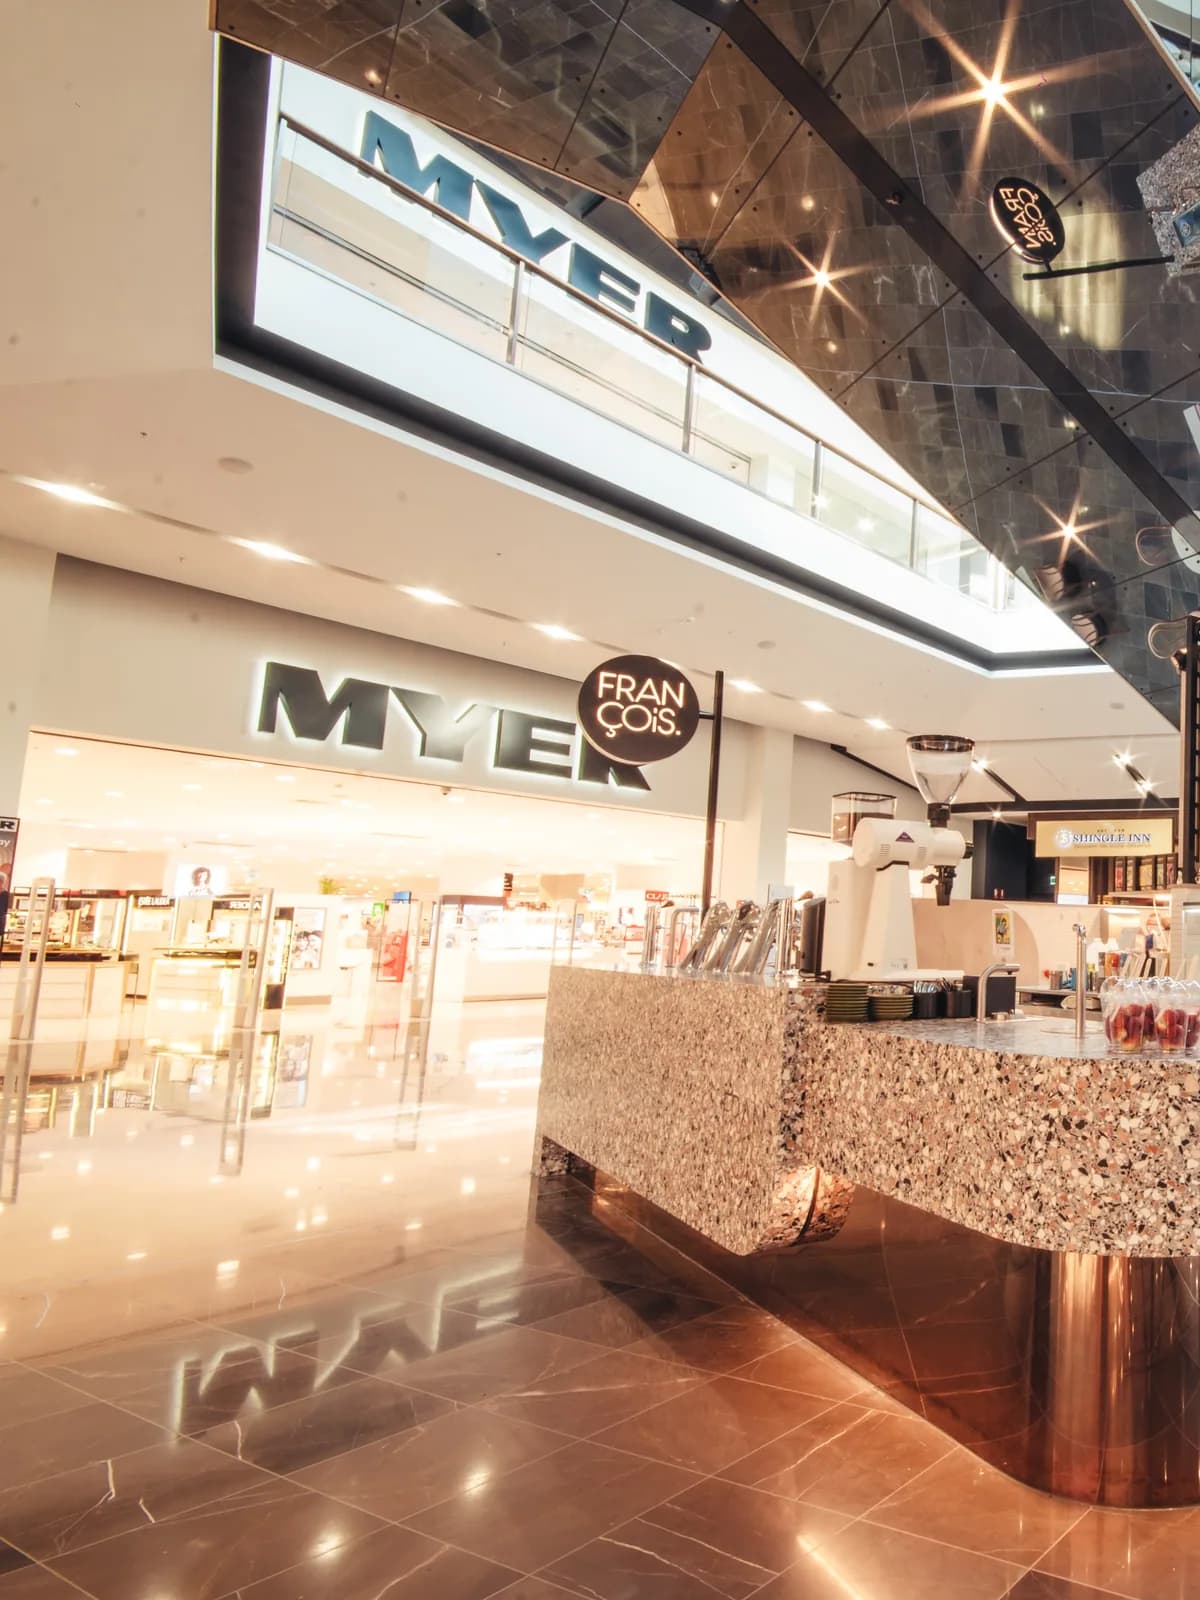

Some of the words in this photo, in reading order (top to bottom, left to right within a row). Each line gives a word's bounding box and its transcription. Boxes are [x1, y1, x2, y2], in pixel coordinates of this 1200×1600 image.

[358, 110, 713, 366] MYER
[598, 671, 684, 708] FRAN
[1073, 832, 1126, 844] SHINGLE
[1129, 833, 1151, 843] INN
